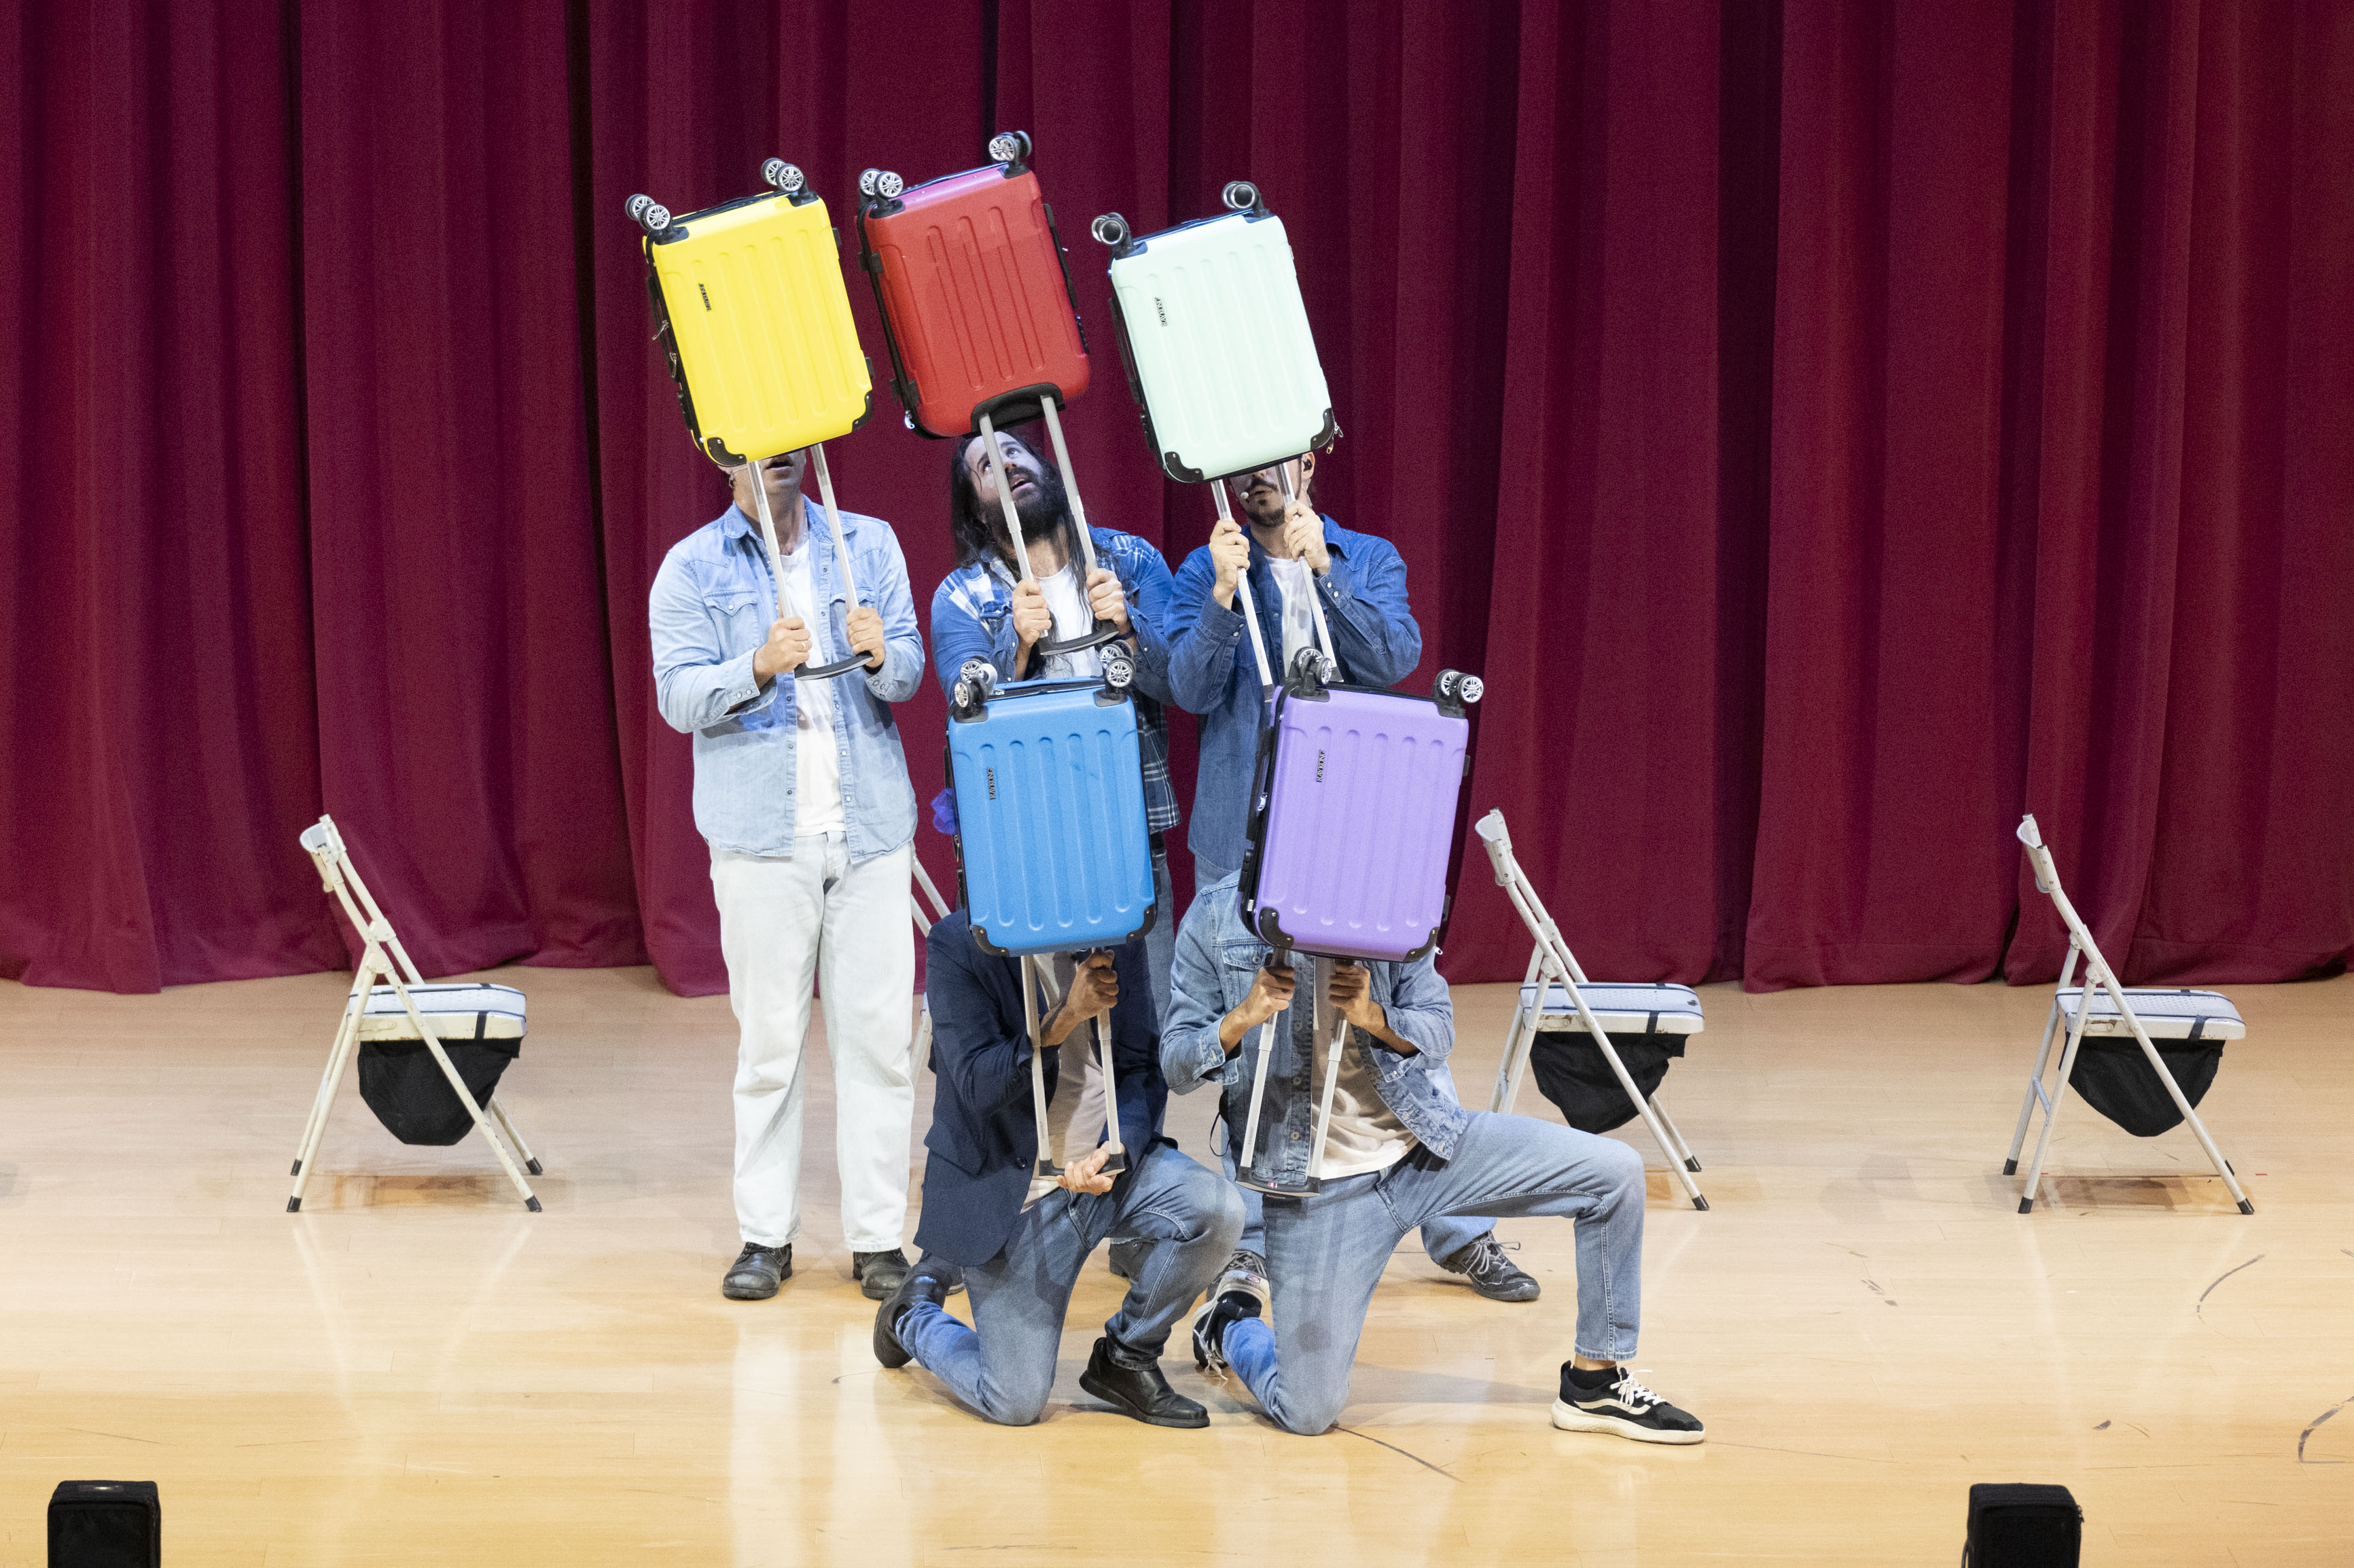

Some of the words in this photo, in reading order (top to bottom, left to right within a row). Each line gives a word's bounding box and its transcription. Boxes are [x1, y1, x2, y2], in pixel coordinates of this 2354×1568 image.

[698, 283, 711, 311] RAYKONG
[1155, 297, 1168, 327] RAYKONG
[1317, 749, 1325, 783] RAYKONG
[987, 767, 995, 800] RAYKONG
